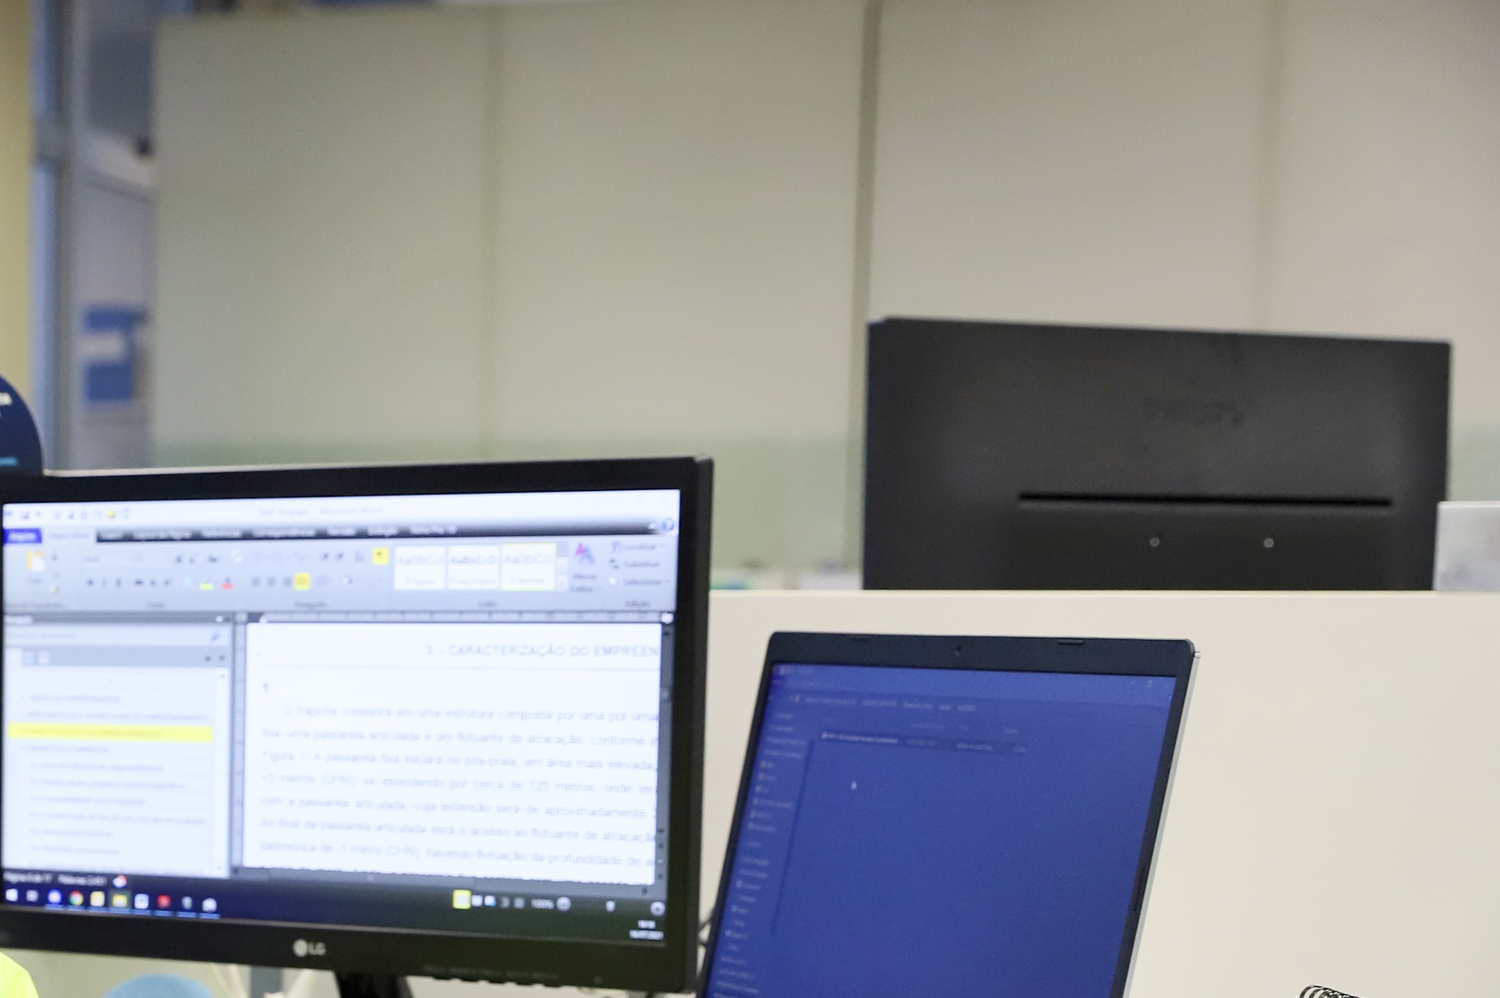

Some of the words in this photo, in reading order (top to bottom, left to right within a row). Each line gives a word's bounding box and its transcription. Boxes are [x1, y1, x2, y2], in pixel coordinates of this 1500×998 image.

[446, 642, 568, 656] CARACTERIZAÇÃO
[568, 643, 591, 657] DO
[308, 942, 326, 956] LG
